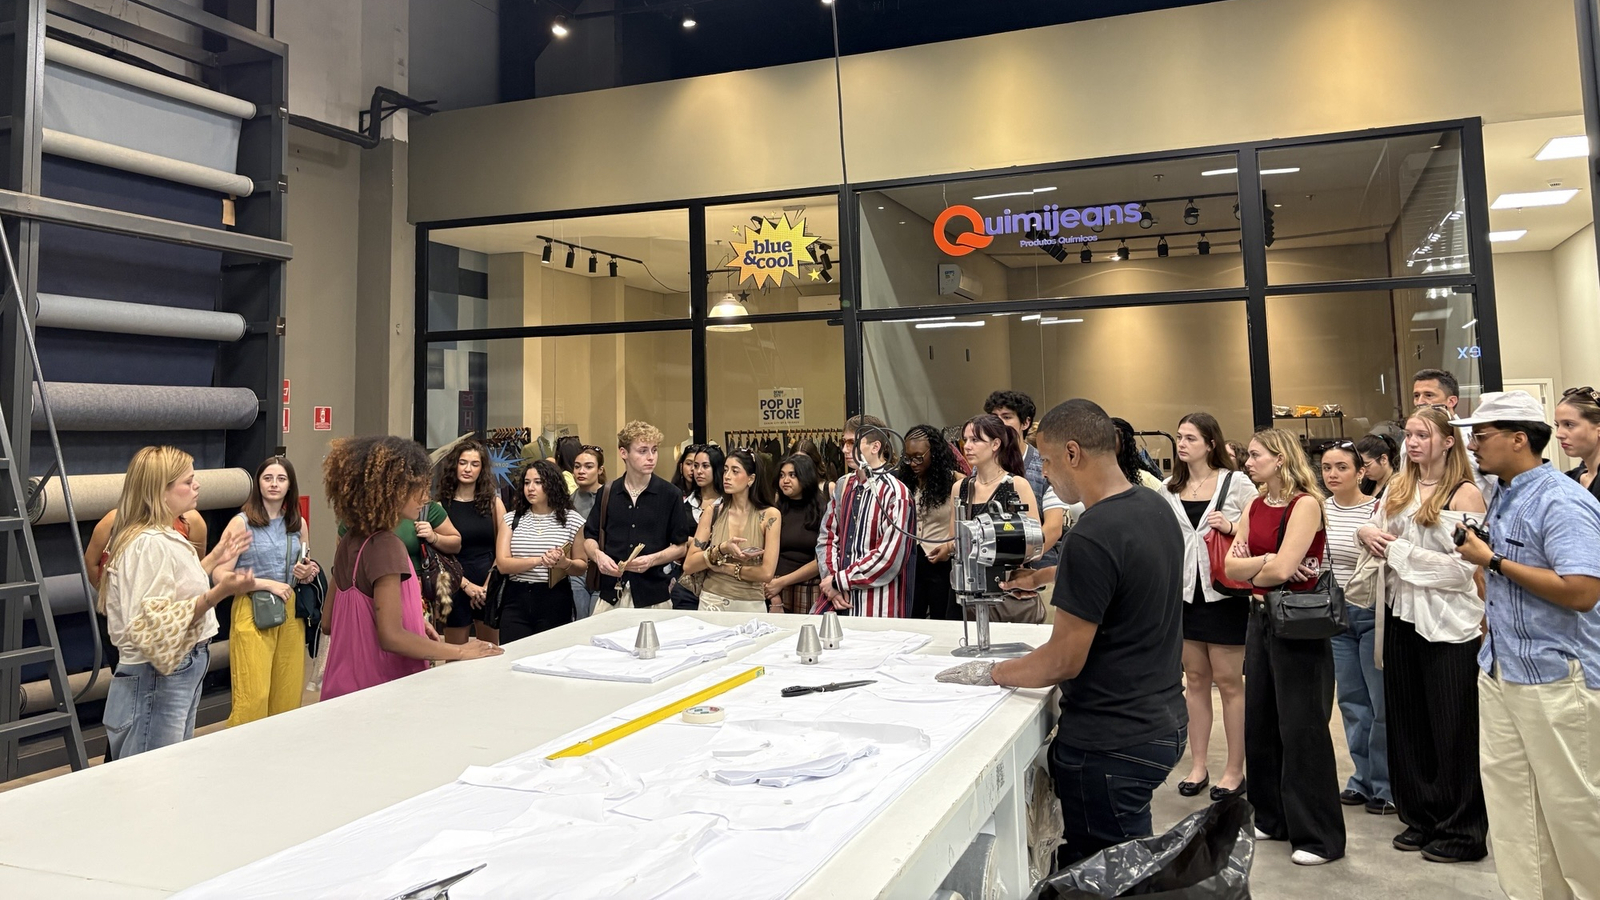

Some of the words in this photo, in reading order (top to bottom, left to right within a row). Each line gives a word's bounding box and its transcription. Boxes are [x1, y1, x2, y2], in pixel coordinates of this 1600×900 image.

[933, 203, 1142, 257] Quimijeans
[753, 239, 793, 255] blue
[1020, 238, 1057, 248] Produtos
[1058, 234, 1098, 245] Químicos
[743, 251, 794, 270] &cool
[760, 399, 784, 410] POP
[786, 398, 802, 409] UP
[763, 409, 800, 420] STORE
